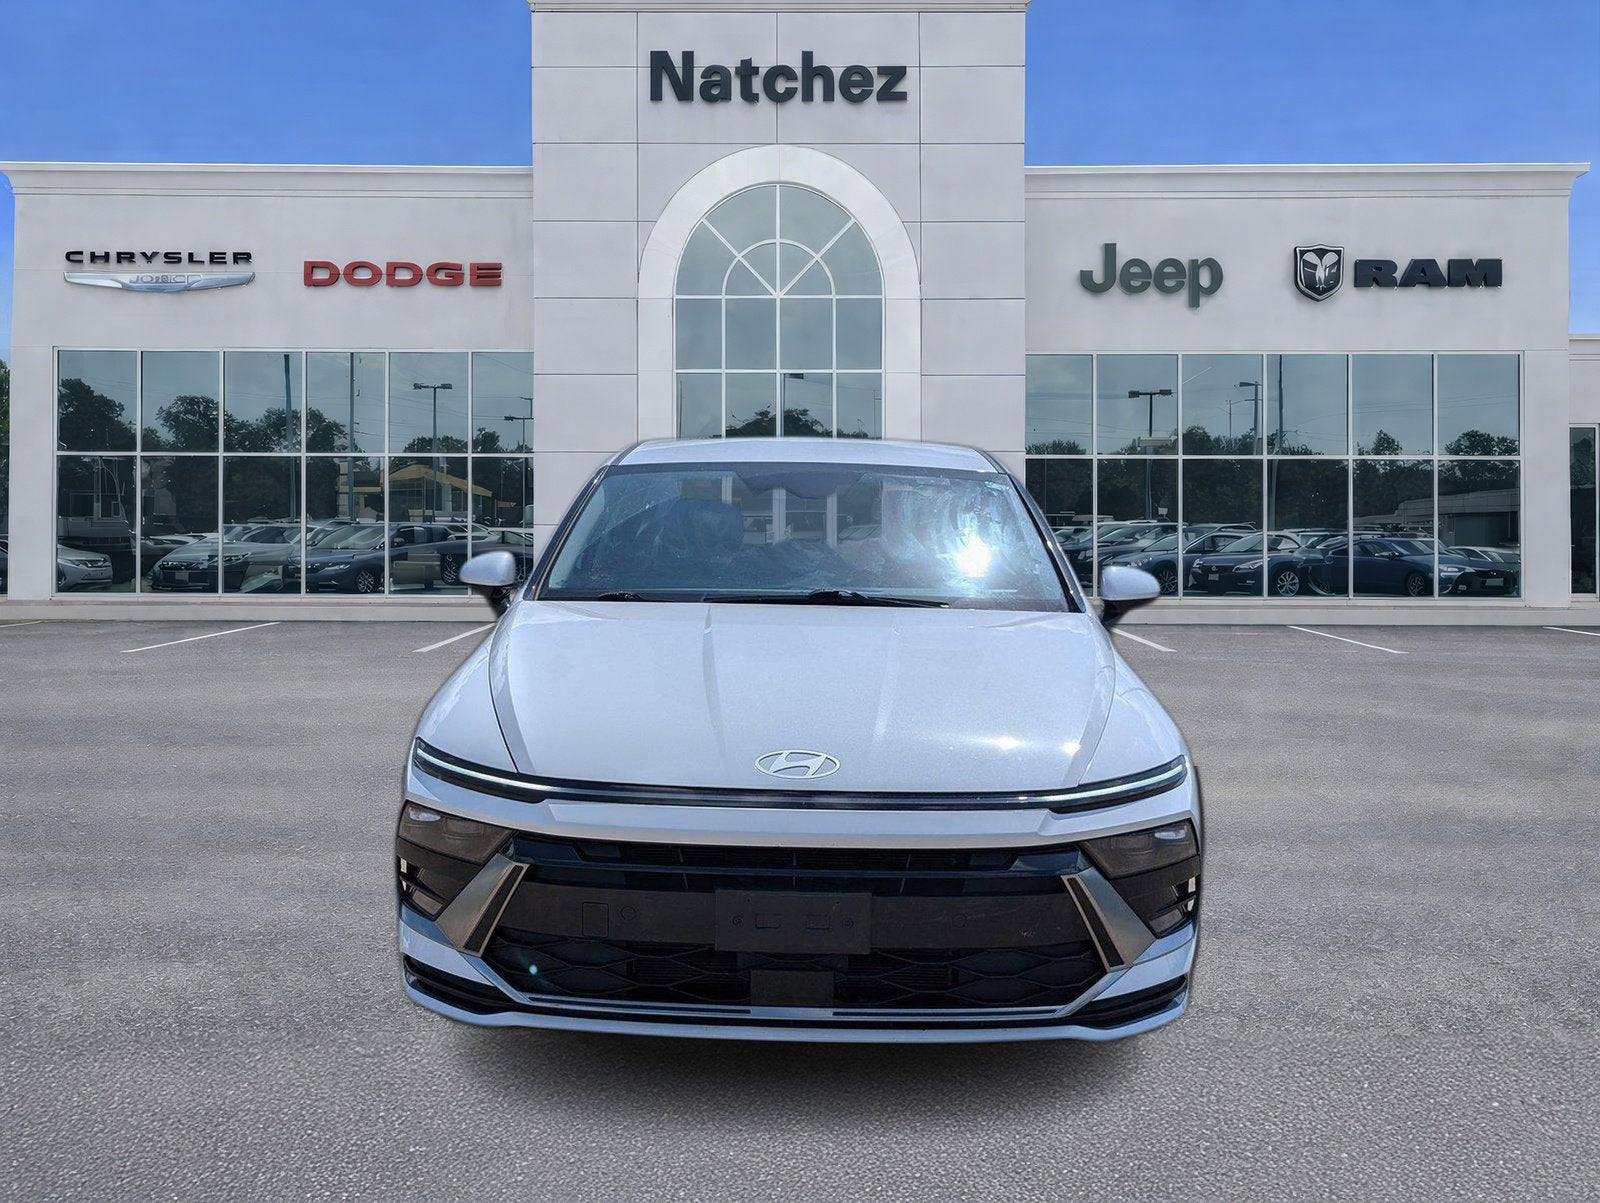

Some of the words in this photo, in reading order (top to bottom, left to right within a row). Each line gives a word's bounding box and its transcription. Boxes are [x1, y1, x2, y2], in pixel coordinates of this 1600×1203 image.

[650, 51, 908, 103] Natchez
[65, 251, 253, 264] CHRYSLER
[304, 261, 503, 287] DODGE
[1080, 243, 1224, 308] Jeep
[1354, 258, 1502, 288] RAM
